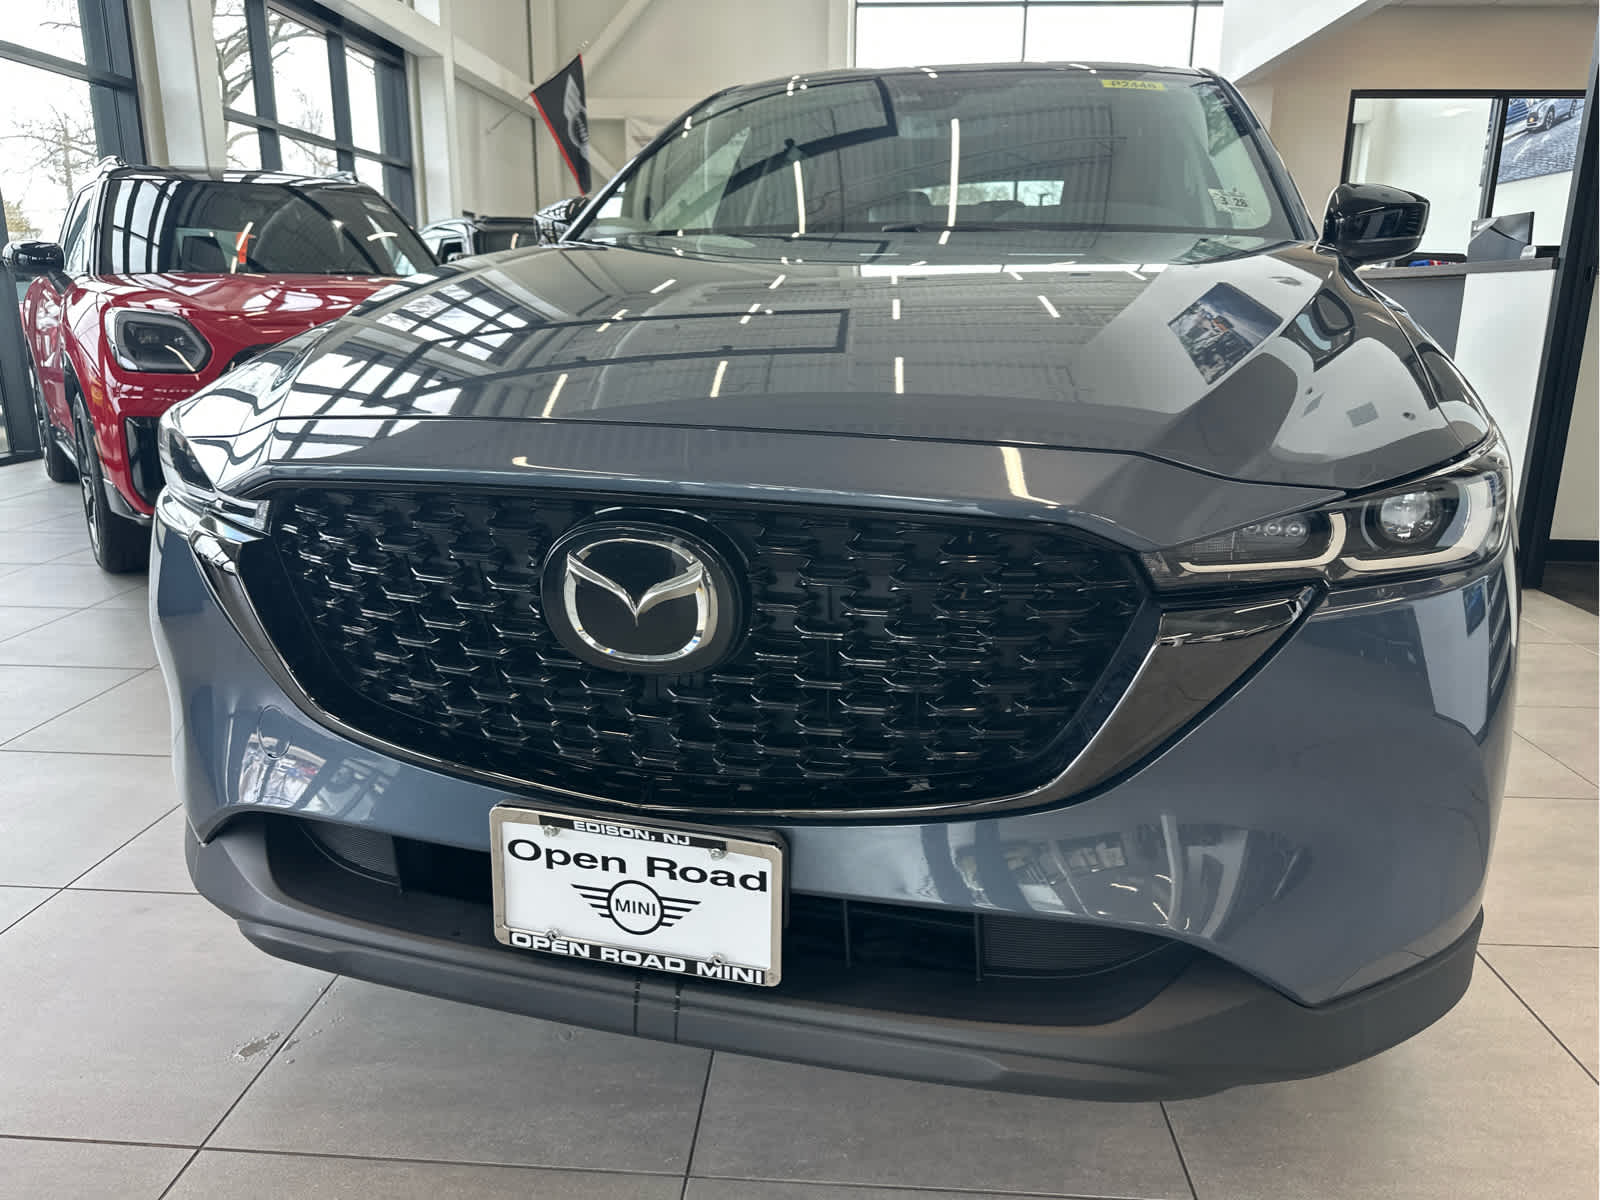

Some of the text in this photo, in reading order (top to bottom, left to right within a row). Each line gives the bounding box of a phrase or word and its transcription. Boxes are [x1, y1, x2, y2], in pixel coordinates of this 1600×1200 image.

[573, 820, 691, 847] EDISON, NJ
[507, 838, 768, 893] Open Road
[614, 898, 657, 917] MINI
[510, 932, 763, 985] OPEN ROAD MINI
